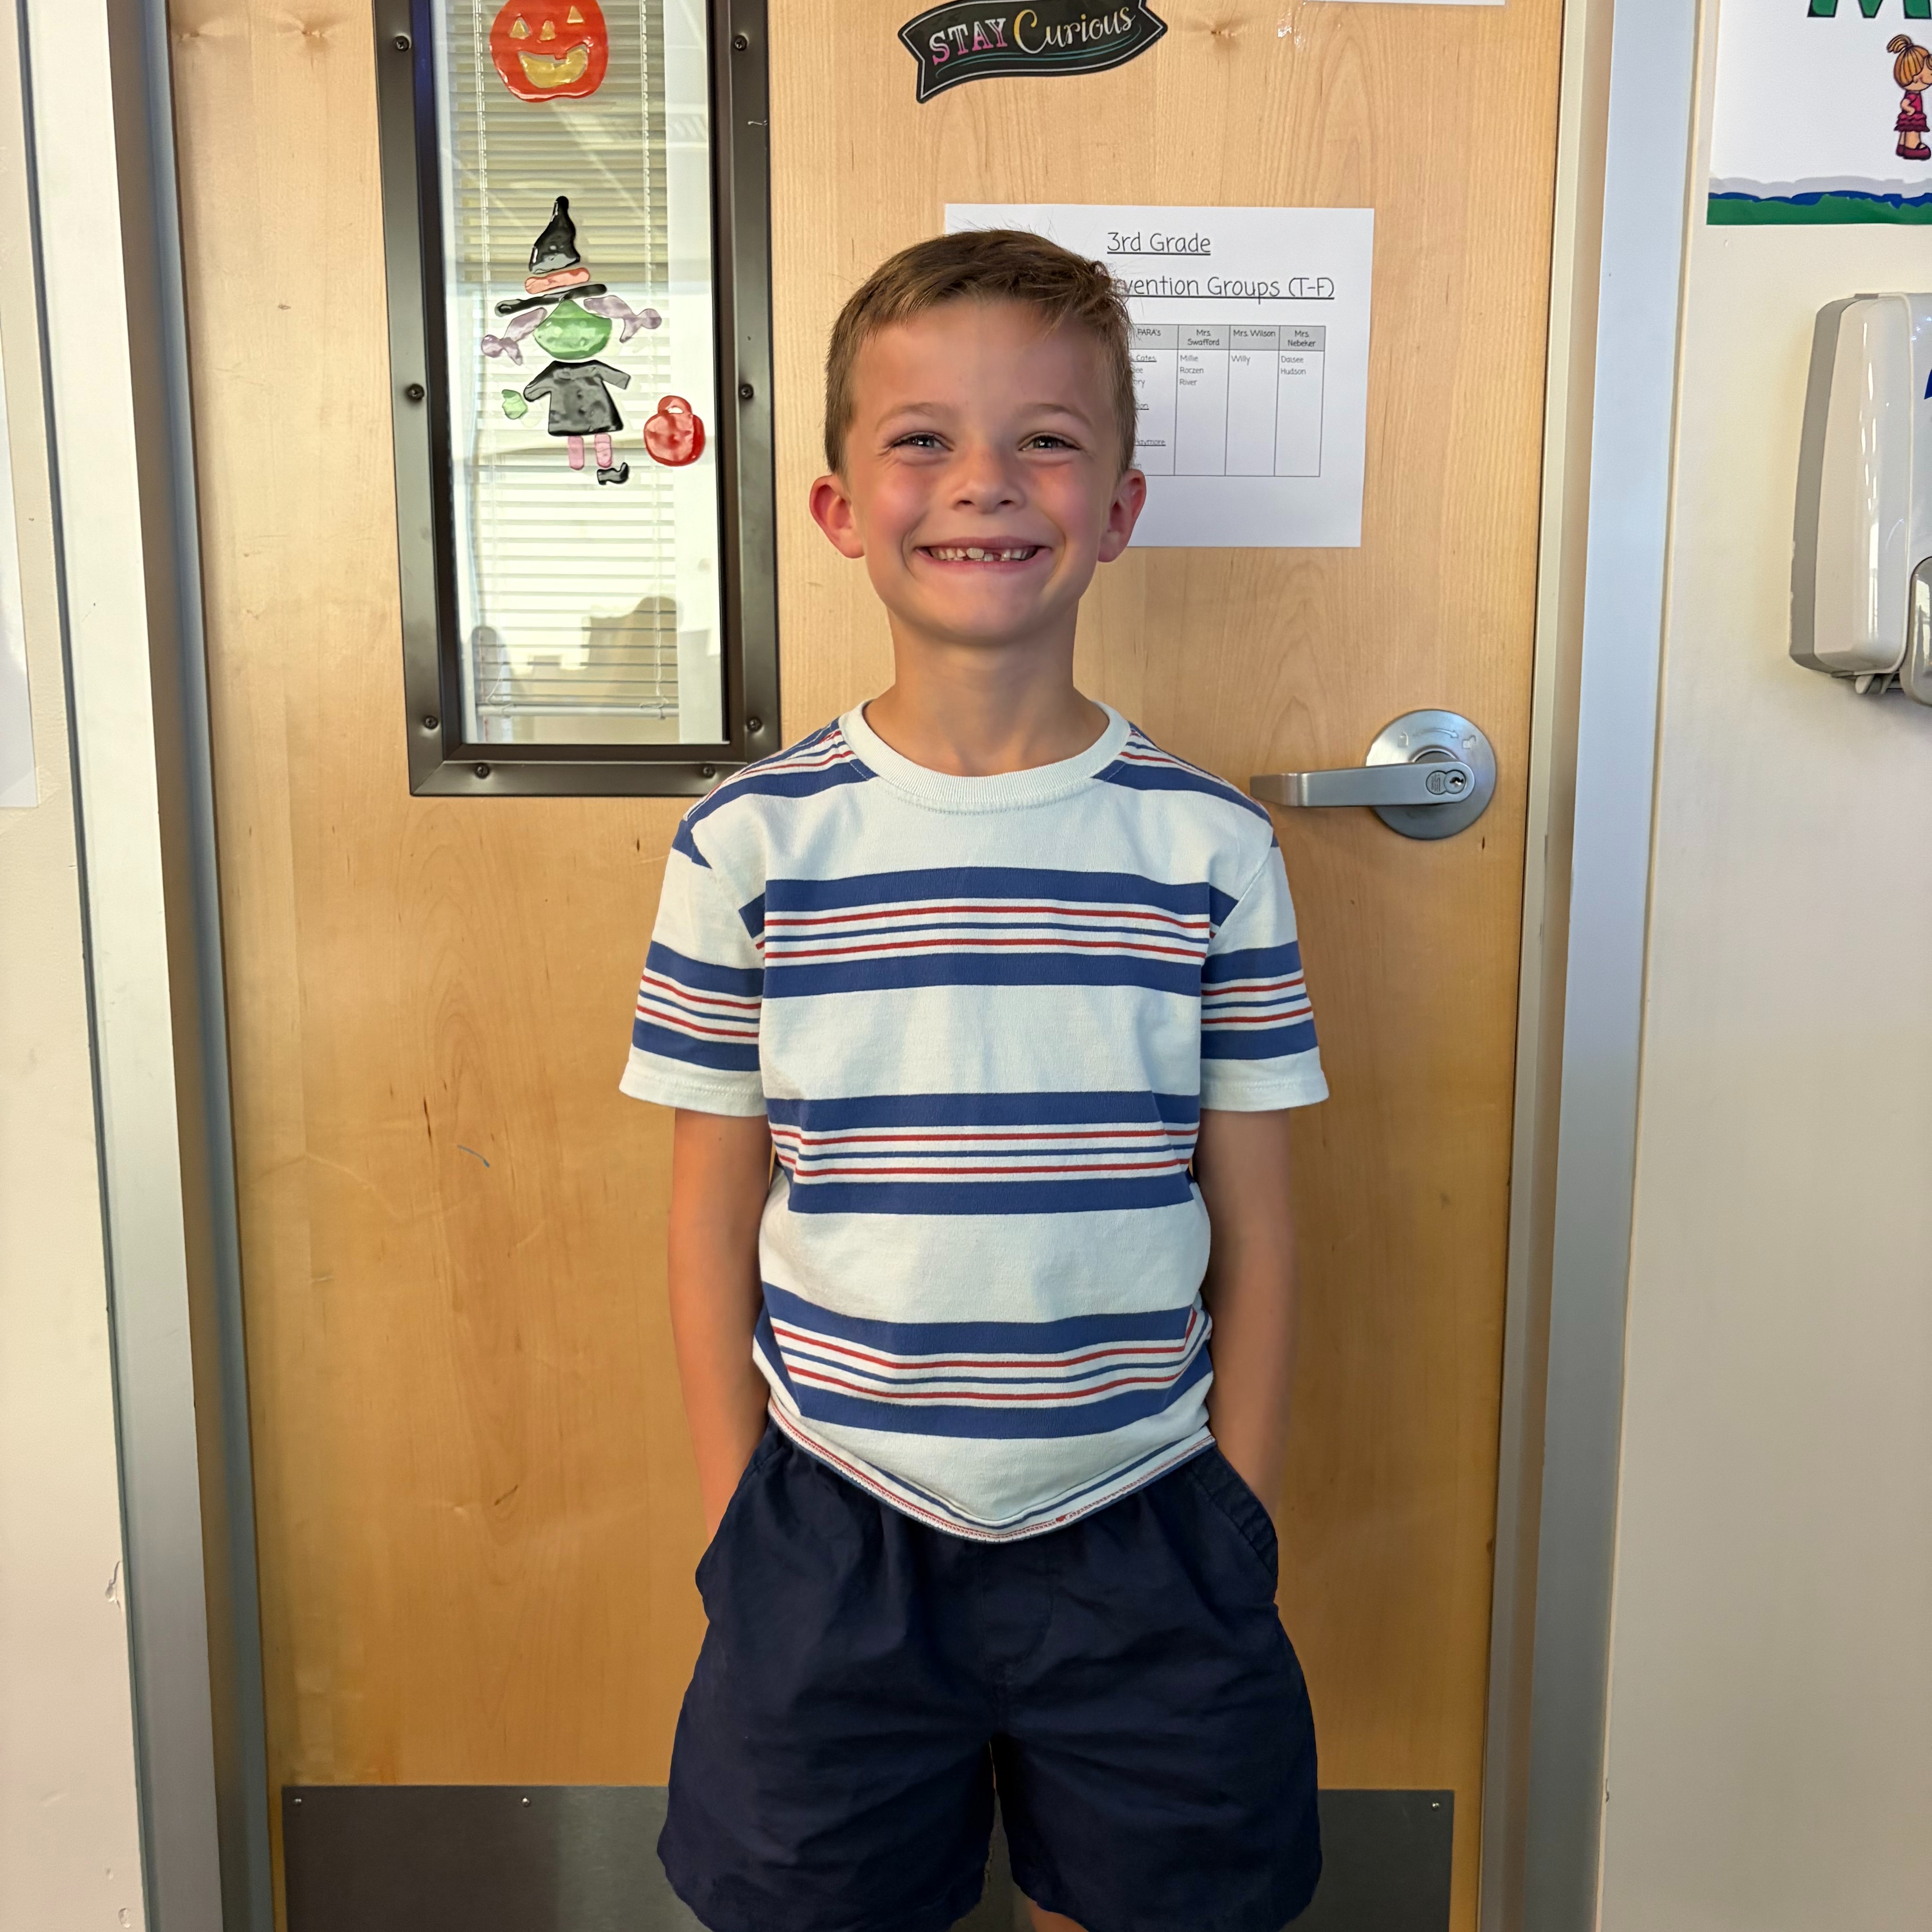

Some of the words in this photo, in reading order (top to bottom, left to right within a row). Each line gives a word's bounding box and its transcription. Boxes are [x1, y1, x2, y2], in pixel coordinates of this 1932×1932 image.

[929, 18, 1007, 65] STAY
[1014, 7, 1136, 54] Curious
[1108, 232, 1141, 251] 3rd
[1150, 233, 1211, 253] Grade
[1124, 276, 1199, 295] vention
[1207, 276, 1280, 304] Groups
[1288, 277, 1334, 297] (T-F)
[1231, 355, 1250, 366] Willy
